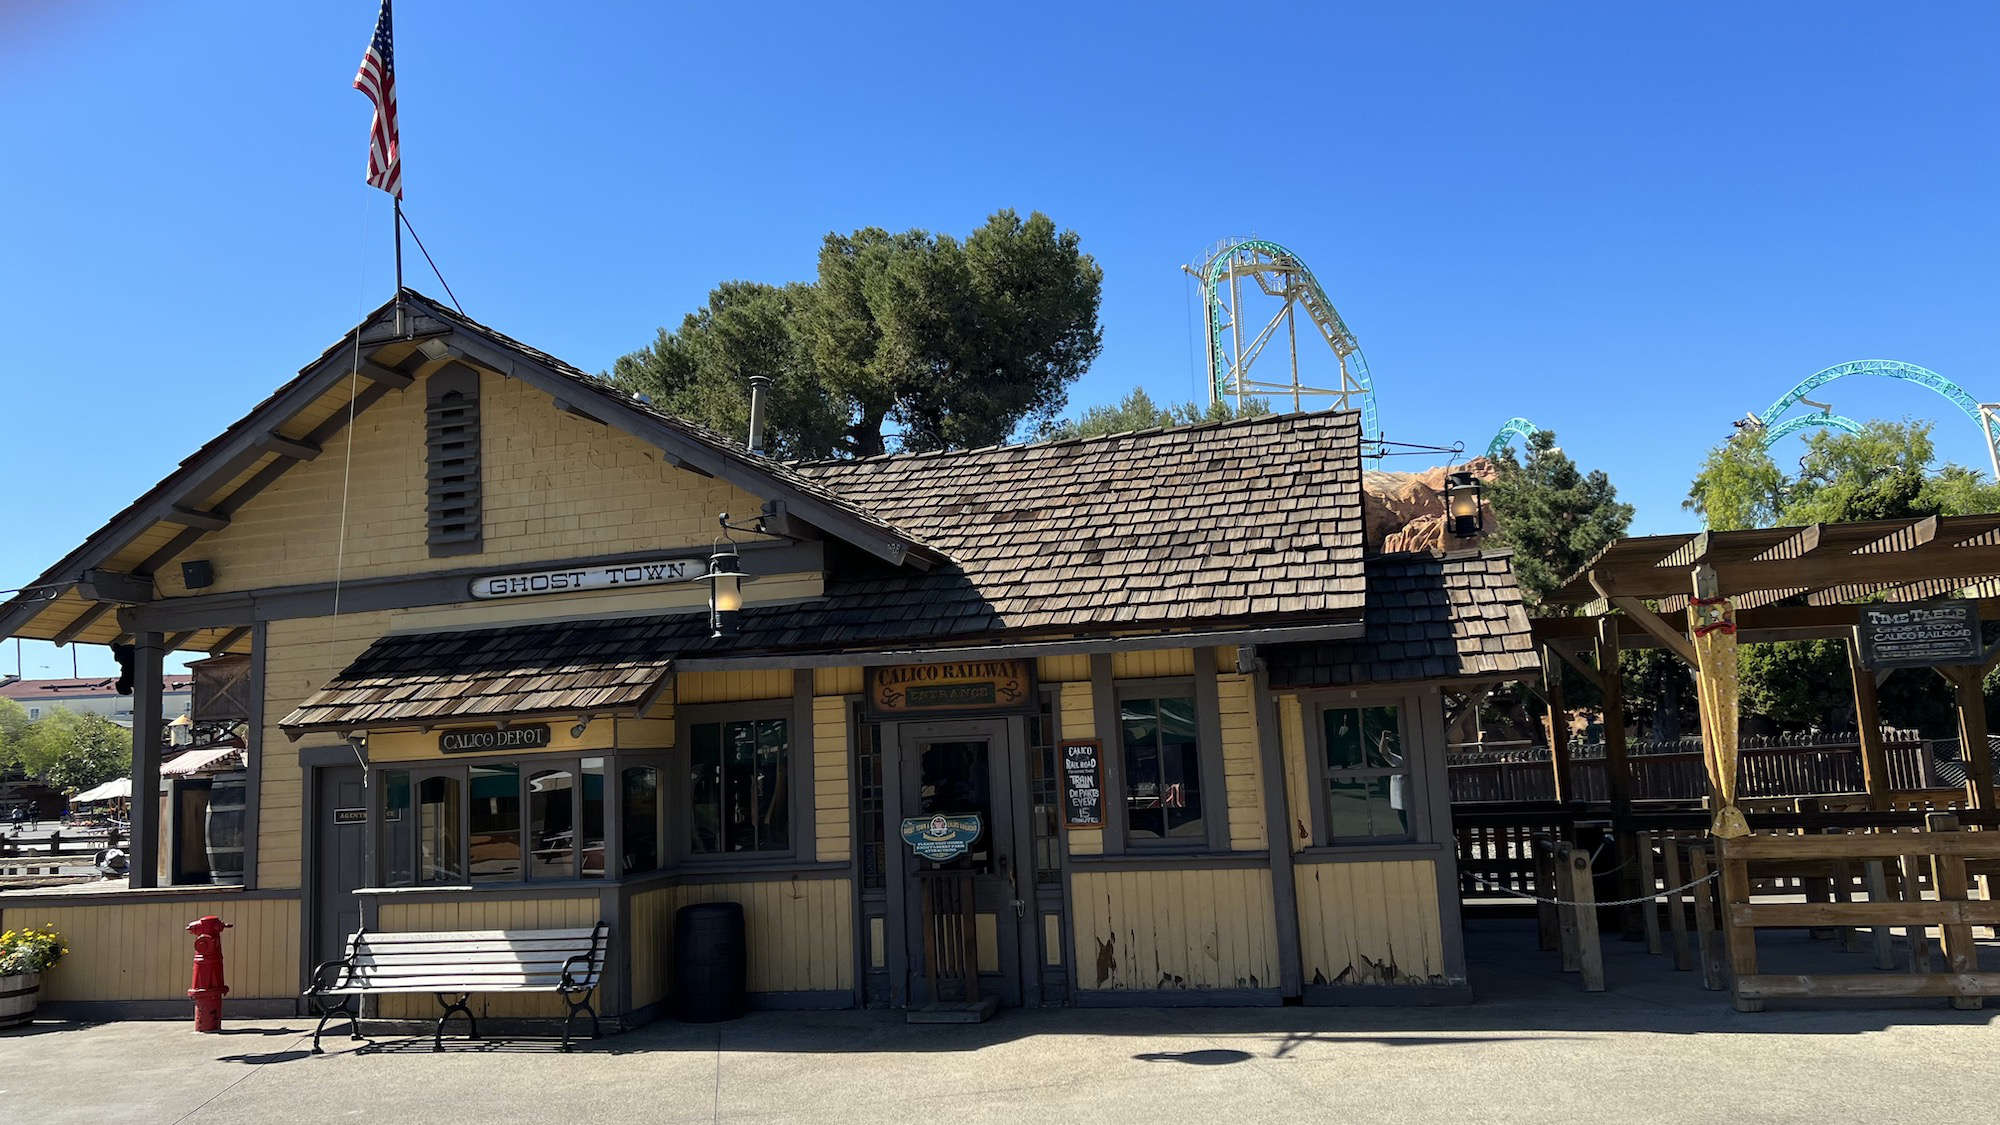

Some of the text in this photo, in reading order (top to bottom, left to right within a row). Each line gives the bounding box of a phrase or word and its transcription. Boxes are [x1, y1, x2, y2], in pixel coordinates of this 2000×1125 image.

[489, 562, 686, 595] GHOST TOWN
[1868, 608, 1967, 624] TIME TABLE
[1876, 622, 1965, 633] GHOST TOWN
[1873, 628, 1972, 642] CALICO RAILROAD
[878, 661, 1019, 686] CALICO RAILWAY
[443, 728, 544, 750] CALICO DEPOT
[1068, 746, 1092, 757] CALICO
[1069, 775, 1094, 787] TRAIN
[1072, 798, 1097, 808] EVERY
[1079, 807, 1090, 818] 15
